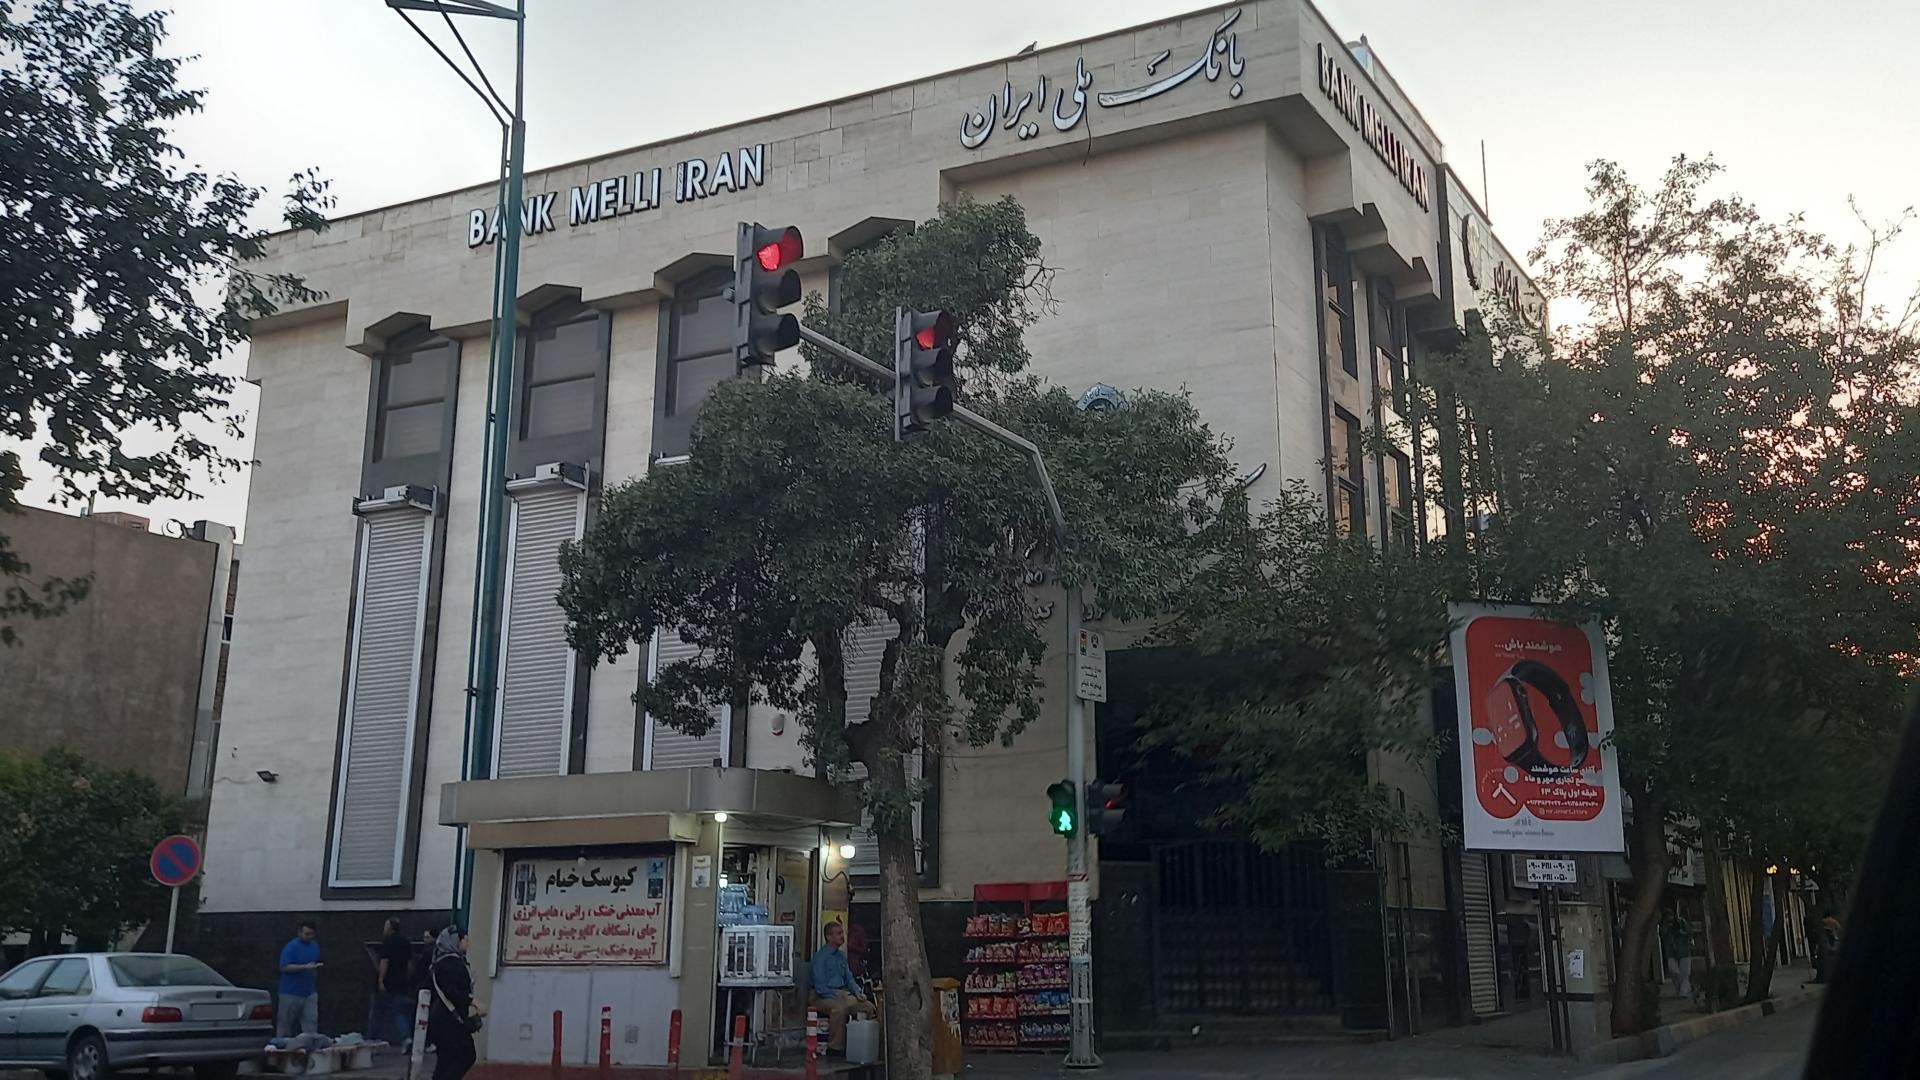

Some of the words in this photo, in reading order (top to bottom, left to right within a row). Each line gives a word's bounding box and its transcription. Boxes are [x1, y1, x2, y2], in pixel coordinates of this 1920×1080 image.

[1098, 8, 1245, 108] بانک
[1053, 56, 1092, 131] ملی
[960, 75, 1046, 149] ایران
[1318, 43, 1360, 131] BANK
[1360, 95, 1398, 178] MELLI
[1397, 142, 1429, 213] IRAN
[468, 191, 557, 248] BANK
[569, 168, 661, 226] MELLI
[676, 144, 765, 203] IRAN
[1525, 640, 1562, 653] هوشمند
[1531, 763, 1559, 774] هوشمند
[1560, 764, 1579, 773] ساعت
[1555, 775, 1575, 786] تجاری
[1552, 788, 1567, 799] پلاک
[1567, 788, 1580, 799] اول
[1581, 788, 1598, 799] طبقه
[546, 867, 580, 894] خیام
[582, 866, 638, 893] کیوسک
[616, 904, 646, 920] معدنی
[647, 902, 662, 919] آب
